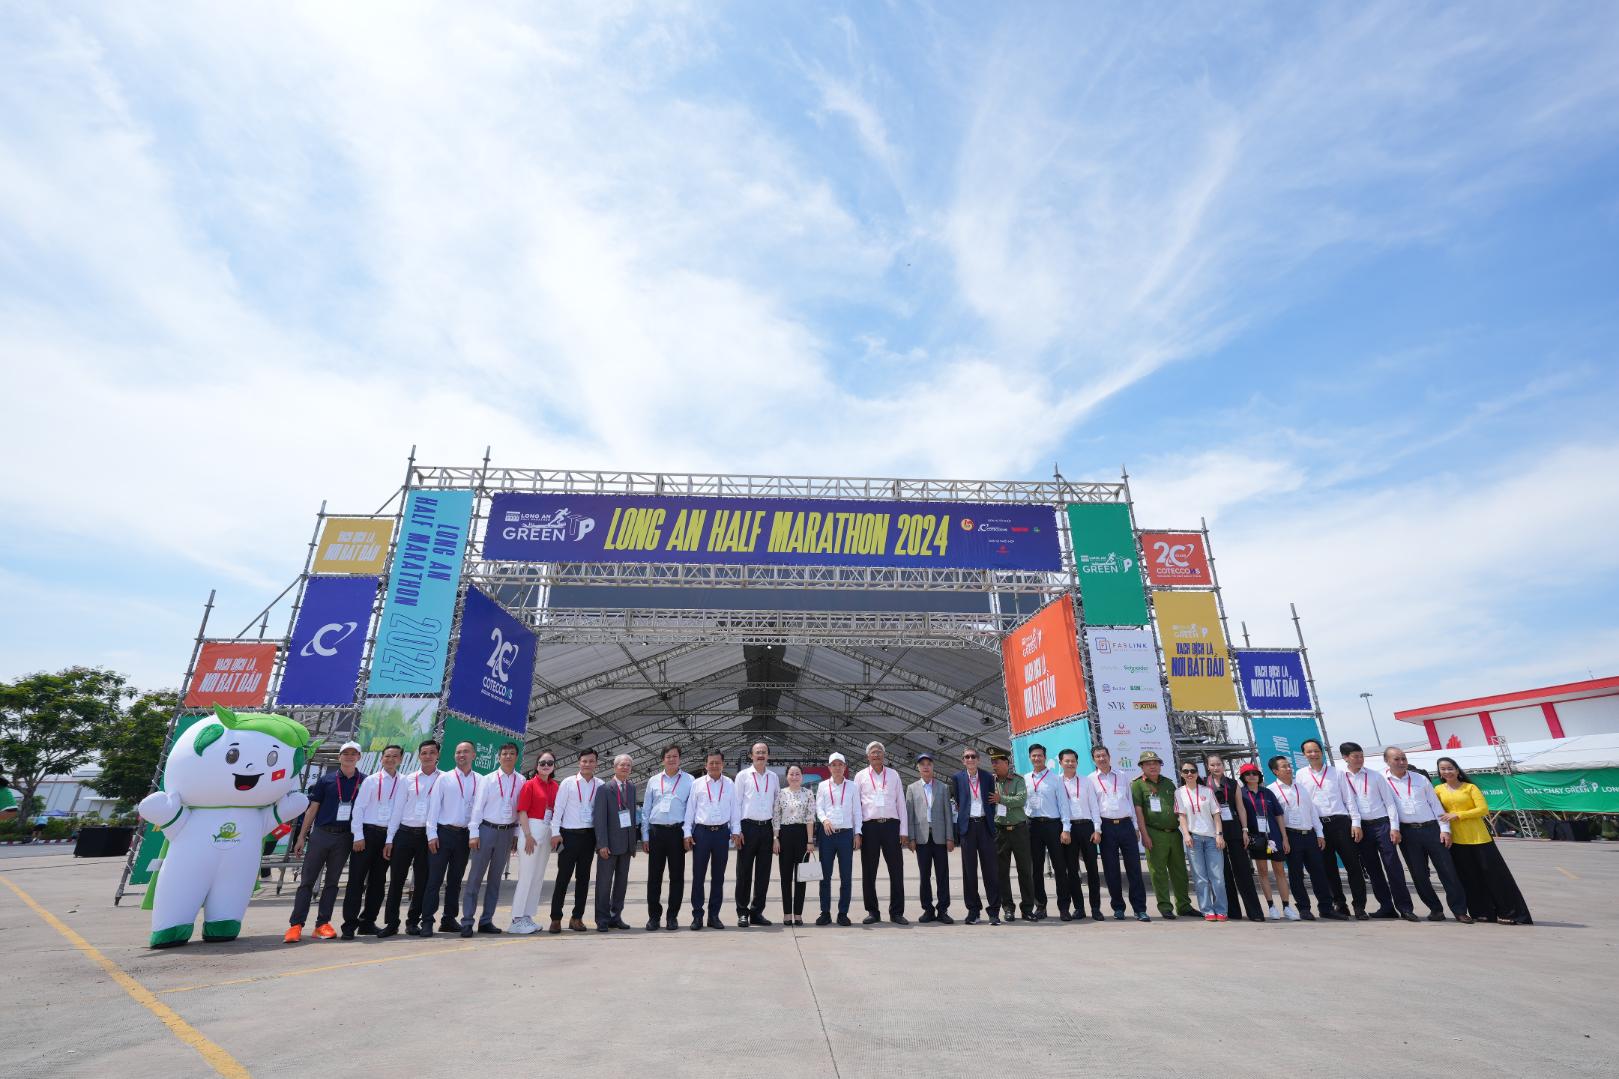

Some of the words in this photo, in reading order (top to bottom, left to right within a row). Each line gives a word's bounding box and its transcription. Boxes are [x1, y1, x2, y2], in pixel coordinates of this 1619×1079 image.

[411, 496, 438, 528] HALF
[432, 524, 460, 556] LONG
[502, 527, 566, 541] GREEN
[604, 508, 666, 550] LONG
[666, 509, 707, 551] AN
[707, 510, 766, 552] HALF
[767, 511, 890, 555] MARATHON
[894, 514, 950, 556] 2024
[394, 532, 431, 606] MARATHON
[427, 560, 452, 581] AN
[1082, 565, 1118, 573] GREEN
[380, 613, 442, 686] 2024
[482, 676, 512, 699] COTECCONS
